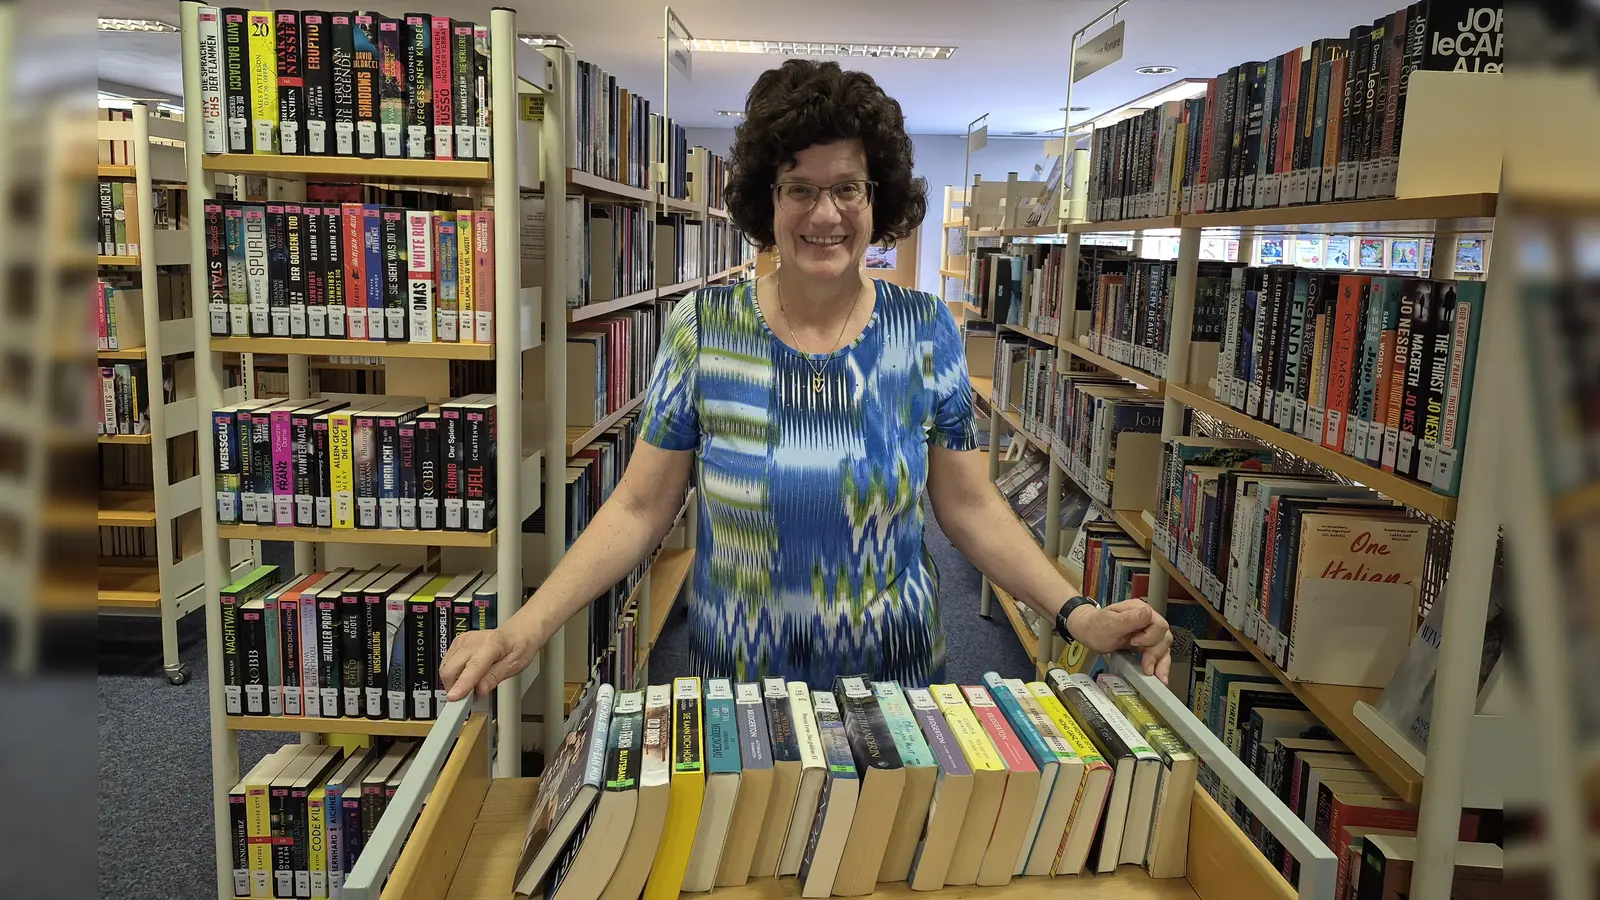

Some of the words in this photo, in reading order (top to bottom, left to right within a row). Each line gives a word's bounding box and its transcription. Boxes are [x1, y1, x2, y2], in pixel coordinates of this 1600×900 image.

[226, 22, 239, 44] AVID
[251, 23, 270, 38] 20
[441, 28, 449, 53] VERRAT
[1412, 16, 1426, 58] JOHN
[199, 40, 208, 79] SPRACHE
[206, 35, 217, 75] FLAMMEN
[286, 26, 297, 74] NESSE
[407, 46, 415, 81] GUNNIS
[1347, 50, 1355, 79] Donna
[1371, 43, 1380, 71] Donna
[227, 46, 242, 91] BALDACCI
[256, 54, 264, 94] PATTERSON
[333, 47, 343, 104] GRISHAM
[341, 52, 352, 105] LEGENDE
[1398, 53, 1411, 96] Leon
[201, 80, 209, 92] DIE
[209, 77, 218, 92] DER
[357, 71, 373, 118] SHADOWS
[415, 60, 425, 126] VERGESSENEN
[459, 75, 468, 118] HAMMESFAHR
[1341, 79, 1355, 117] Leon
[1352, 69, 1368, 115] Leon
[1365, 71, 1380, 109] Leon
[257, 95, 265, 116] JAMES
[1386, 84, 1399, 123] Leon
[100, 195, 111, 218] BOYLE
[288, 215, 298, 230] TOD
[308, 215, 317, 233] ALICE
[328, 215, 336, 233] ALICE
[247, 217, 265, 276] SPURLOS
[289, 232, 300, 265] GOLDENE
[309, 235, 318, 261] HUNTER
[328, 235, 338, 262] HUNTER
[386, 233, 396, 243] DU
[387, 244, 397, 260] WAS
[412, 239, 426, 268] WHITE
[210, 261, 224, 304] STALKE
[290, 266, 301, 281] DER
[308, 270, 316, 305] SERIENKIL
[389, 283, 399, 294] SIE
[1261, 273, 1269, 302] BRAD
[412, 283, 427, 310] OMAS
[1149, 270, 1159, 309] JEFFERY
[1199, 288, 1220, 297] THE
[1306, 277, 1317, 319] LONG
[1400, 295, 1413, 313] JO
[1272, 284, 1282, 331] LIGHTNING
[1145, 310, 1155, 344] DEAVER
[1256, 304, 1267, 353] MELTZER
[1287, 300, 1303, 360] FIND
[1341, 312, 1353, 353] KATE
[1380, 310, 1388, 341] SMALL
[1457, 321, 1466, 338] LADY
[1301, 323, 1311, 373] BRIGHT
[1308, 329, 1316, 357] MOORE
[1394, 318, 1411, 364] NESBO
[1434, 332, 1451, 355] THE
[1359, 347, 1377, 383] Jojo
[1376, 342, 1386, 379] WORLDS
[1407, 333, 1425, 387] MACBETH
[1284, 361, 1298, 394] ME
[1428, 357, 1447, 394] THIRST
[1450, 363, 1460, 389] PRAIRIE
[1389, 384, 1403, 405] NIGHT
[1405, 390, 1417, 409] JO
[1427, 396, 1441, 413] JO
[1446, 395, 1456, 417] THISBE
[447, 419, 455, 445] Spieler
[1134, 412, 1161, 427] JOH
[1443, 418, 1453, 443] NISSEN
[218, 422, 230, 471] WEISSGLU
[240, 424, 250, 476] FRIGHTENED
[332, 446, 340, 469] ALLEIN
[403, 436, 412, 468] KILLER
[279, 461, 288, 491] FRANZ
[382, 444, 393, 490] NORDLICHT
[422, 460, 434, 498] ROBB
[444, 463, 456, 494] LÖHNIG
[468, 465, 483, 493] FJELL
[1267, 507, 1276, 561] SANDFORD
[1350, 532, 1392, 556] One
[1263, 562, 1273, 610] TWISTED
[1321, 560, 1401, 584] Italian
[223, 602, 236, 655] NACHTWAL
[322, 628, 333, 655] KILLER
[372, 630, 382, 674] UNSCHULDIG
[416, 614, 426, 675] MITTSOMME
[366, 653, 374, 686] GRISHAM
[597, 721, 605, 733] DIE
[683, 712, 691, 720] SIE
[683, 720, 691, 735] KANN
[746, 708, 758, 738] BRIDGERTON
[986, 712, 1009, 740] BRIDGERTON
[1228, 698, 1237, 730] THREE
[683, 735, 691, 748] DICH
[926, 714, 946, 745] BRIDGERTON
[1066, 727, 1077, 741] GANZ
[1075, 738, 1085, 750] NAH
[592, 738, 604, 765] HYE-JIN
[588, 766, 599, 781] KIM
[237, 820, 245, 837] HERZ
[312, 824, 322, 852] CODE
